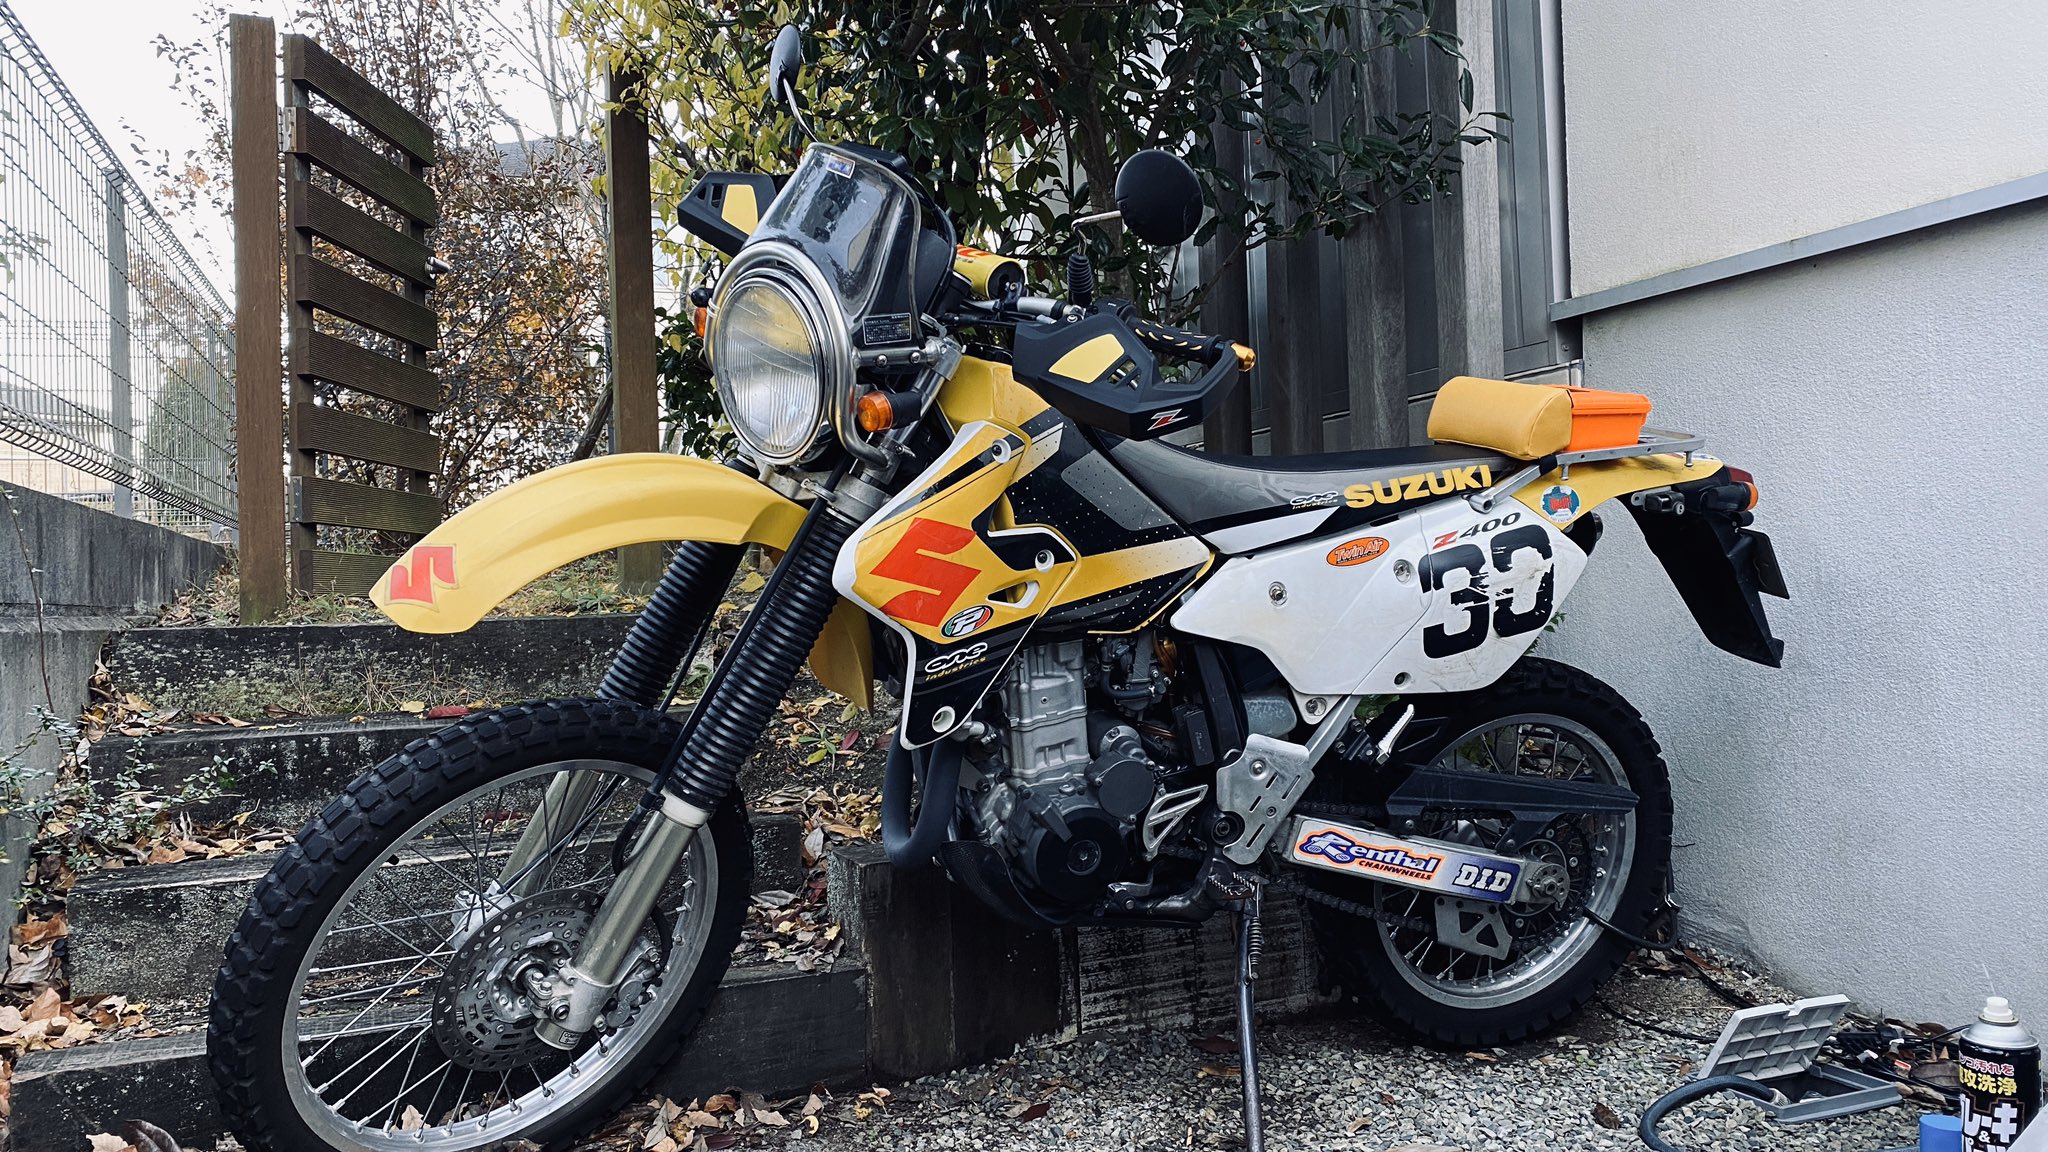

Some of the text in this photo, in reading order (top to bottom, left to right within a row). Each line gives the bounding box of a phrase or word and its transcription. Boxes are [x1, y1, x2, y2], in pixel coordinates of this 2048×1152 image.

[1343, 464, 1492, 509] SUZUKI
[1335, 544, 1364, 562] Twin
[1364, 539, 1384, 554] Air
[1302, 833, 1441, 873] Renthal
[1358, 859, 1433, 882] CHAINWHEELS
[1978, 1130, 1991, 1144] &
